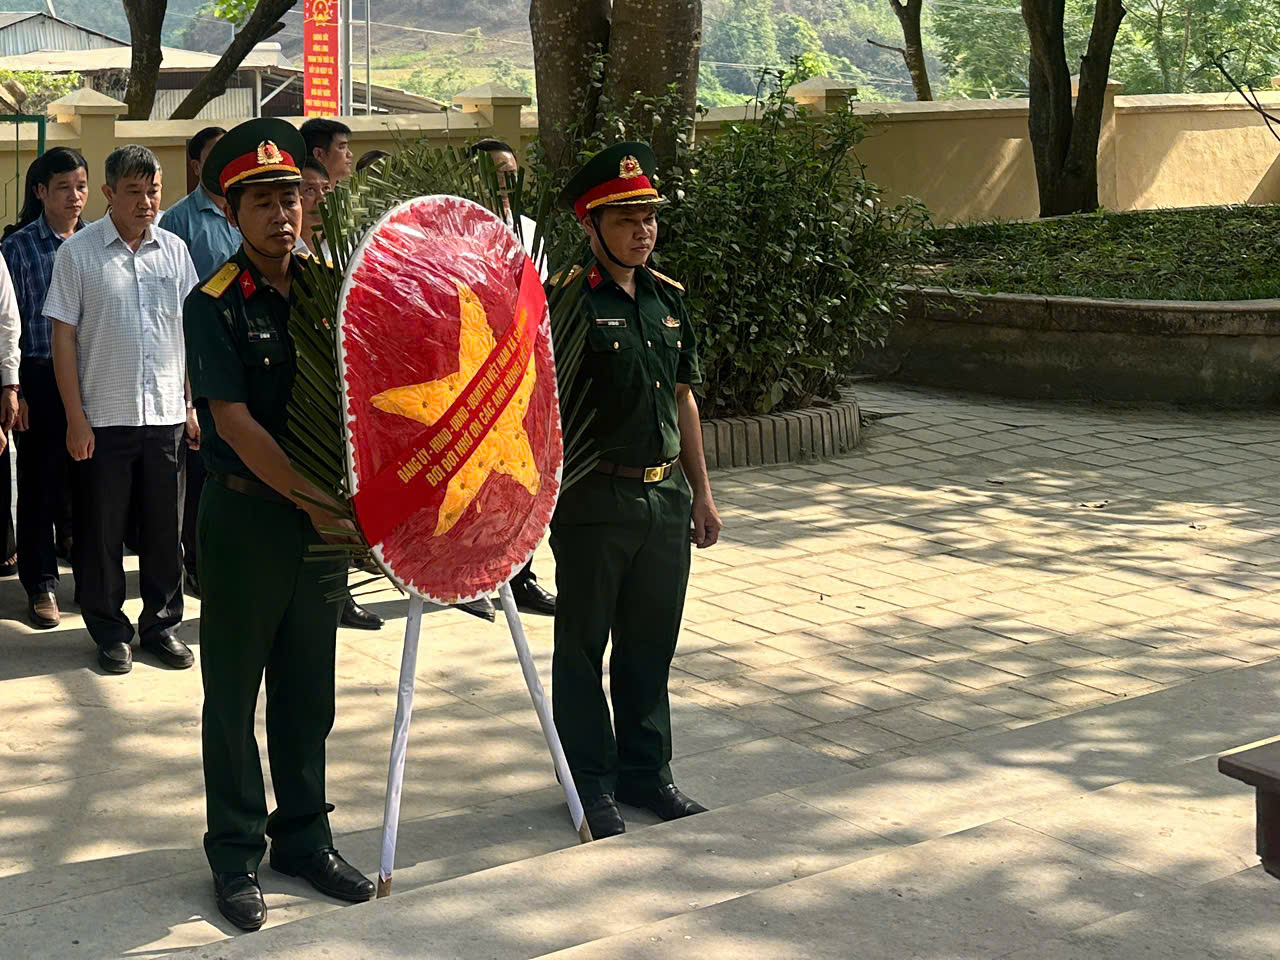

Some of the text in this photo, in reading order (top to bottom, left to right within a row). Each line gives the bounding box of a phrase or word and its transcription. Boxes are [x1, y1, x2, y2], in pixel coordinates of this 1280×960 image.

[396, 457, 423, 484] ĐẢNG
[449, 406, 469, 431] UBND
[496, 346, 512, 369] NAM
[425, 464, 446, 487] ĐỜI
[440, 450, 459, 472] ĐỜI
[454, 430, 473, 457] NHỚ
[479, 402, 495, 424] CÁC
[491, 383, 508, 408] ANH
[504, 361, 522, 390] HÙNG
